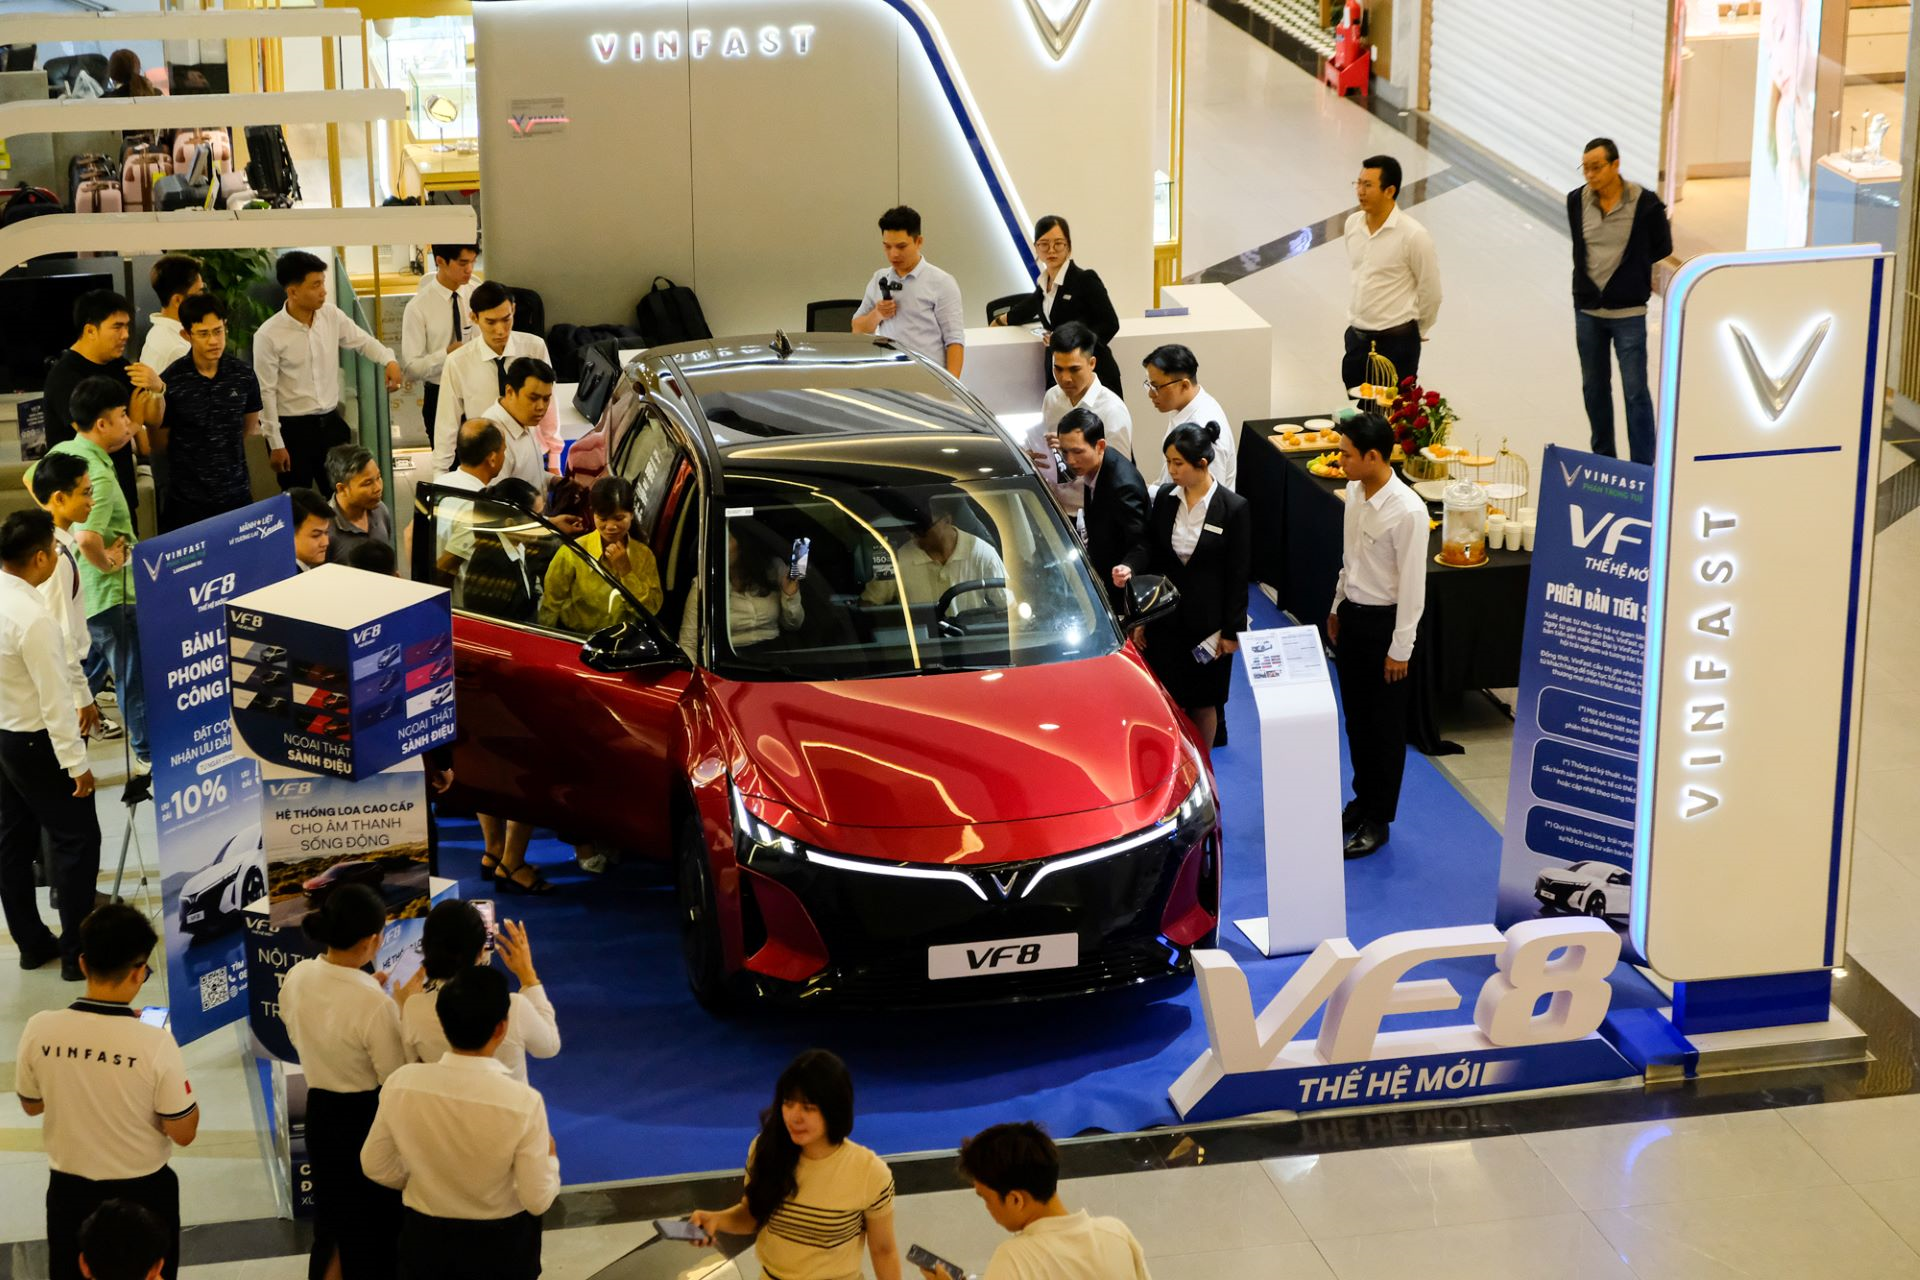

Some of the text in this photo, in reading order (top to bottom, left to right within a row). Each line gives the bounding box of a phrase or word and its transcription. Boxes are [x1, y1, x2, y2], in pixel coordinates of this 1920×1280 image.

[592, 26, 814, 62] VINFAST
[1584, 469, 1646, 491] VINFAST
[1569, 503, 1652, 555] VF
[165, 540, 206, 560] VINFAST
[1585, 557, 1649, 582] THẾ HỆ MỚ
[189, 573, 236, 606] VF8
[1546, 582, 1582, 608] PHIÊN
[1585, 588, 1610, 614] BẢN
[231, 610, 263, 628] VF8
[182, 631, 214, 658] BẢN
[353, 624, 381, 645] VF8
[168, 654, 224, 690] PHONG
[1685, 511, 1737, 818] VINFAST
[177, 681, 224, 711] CÔNG
[398, 707, 454, 740] NGOẠI THẤT
[284, 733, 351, 758] NGOẠI THẤT
[401, 723, 455, 754] SÀNH ĐIỆU
[171, 748, 199, 767] NHẬN
[288, 749, 352, 774] SÀNH ĐIỆU
[269, 782, 312, 796] VF8
[1623, 773, 1636, 782] tran
[171, 774, 227, 820] 10%
[276, 800, 414, 821] HỆ THỐNG LOA CAO CẤP
[290, 817, 401, 835] CHO ÂM THANH
[301, 833, 390, 851] SỐNG ĐỘNG
[258, 947, 288, 968] NỘI
[966, 944, 1041, 970] VF8
[1191, 916, 1622, 1075] VF8
[42, 1046, 137, 1068] VINFAST
[1299, 1058, 1485, 1103] THẾ HỆ MỚI
